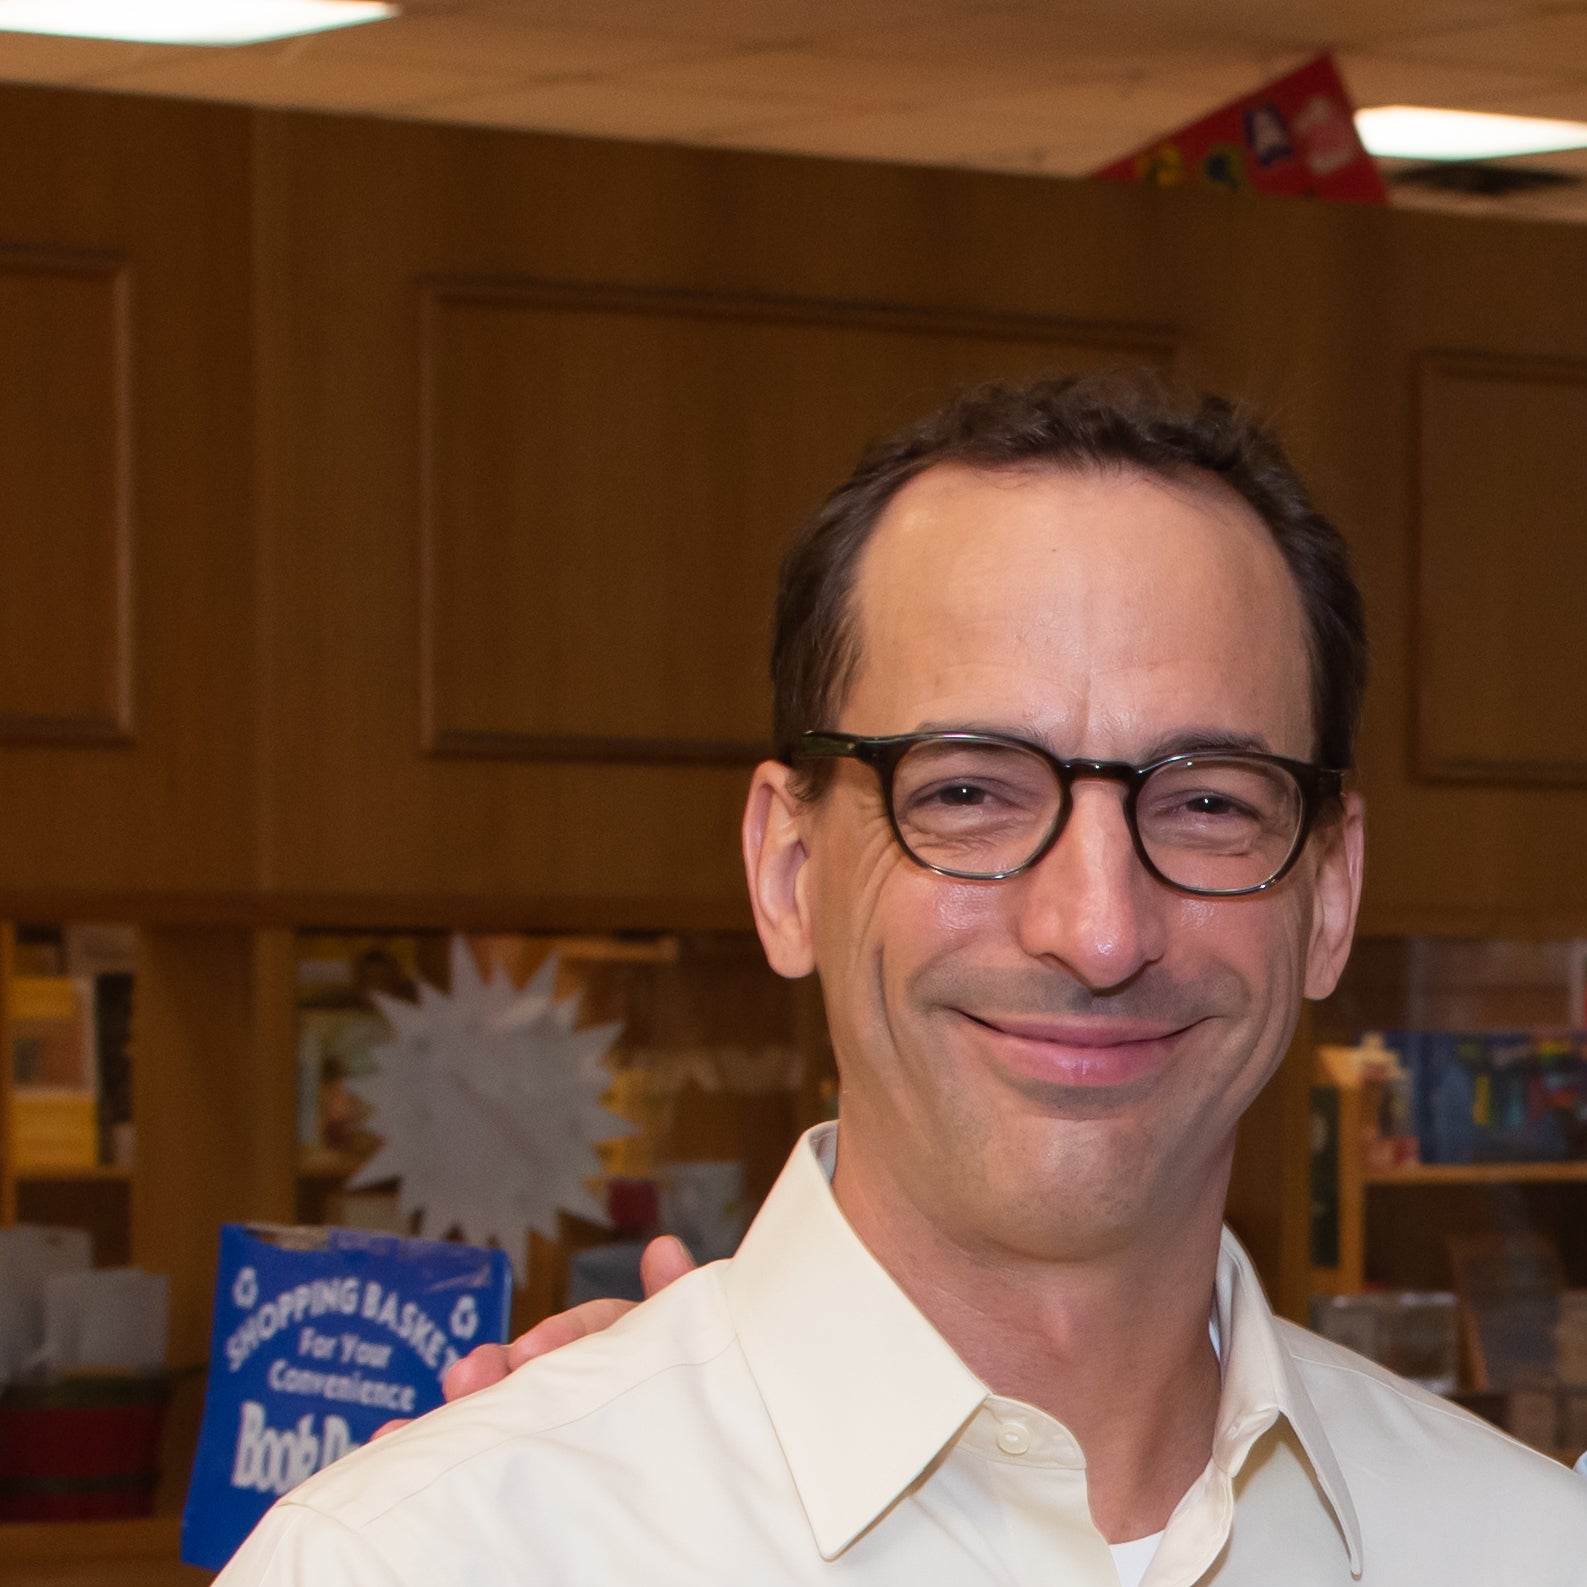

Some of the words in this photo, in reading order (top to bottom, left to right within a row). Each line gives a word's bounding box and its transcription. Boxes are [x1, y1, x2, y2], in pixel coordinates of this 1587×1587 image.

[225, 1275, 360, 1373] SHOPPING
[301, 1326, 338, 1360] For
[340, 1331, 393, 1370] Your
[267, 1358, 416, 1412] Convenience
